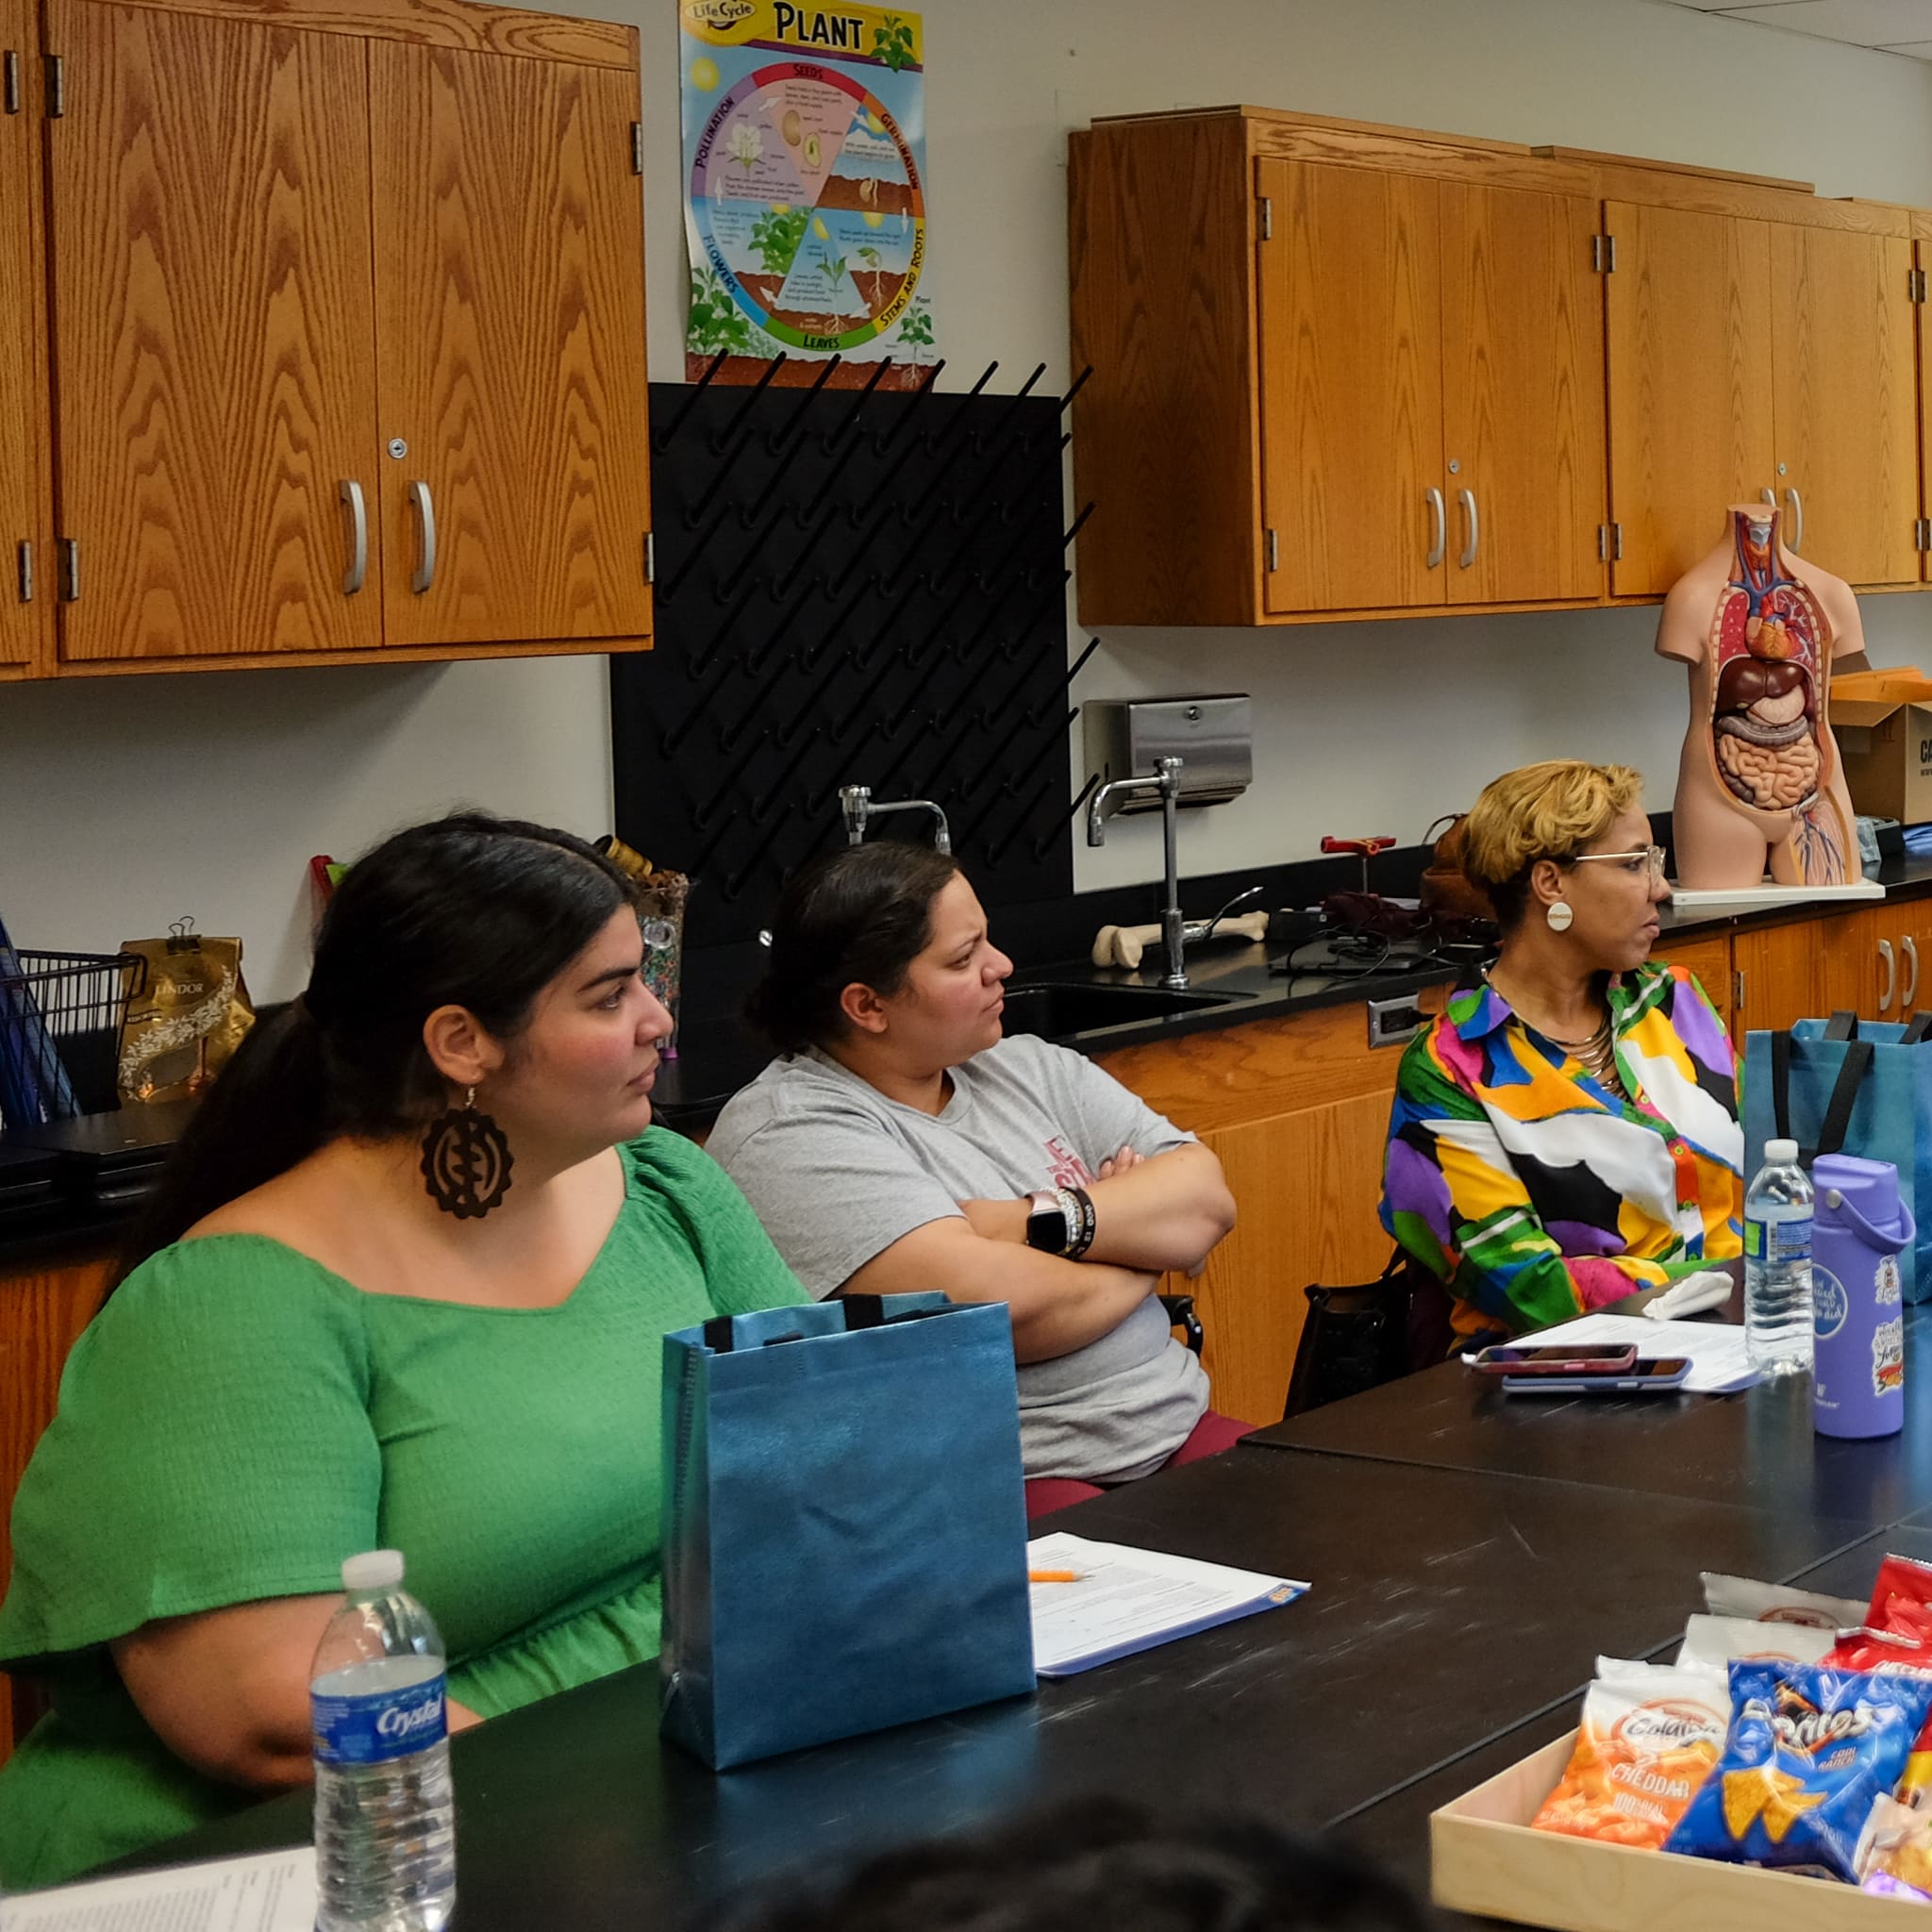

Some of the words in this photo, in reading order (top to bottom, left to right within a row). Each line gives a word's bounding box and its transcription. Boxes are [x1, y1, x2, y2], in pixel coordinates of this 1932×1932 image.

[774, 2, 863, 49] PLANT
[793, 63, 823, 79] SEEDS
[695, 97, 735, 169] POLLINATION
[881, 113, 919, 190] GERMINATION
[704, 234, 739, 293] FLOWERS
[910, 228, 925, 268] ROOTS
[904, 272, 917, 294] AND
[880, 296, 907, 327] STEMS
[804, 334, 841, 349] LEAVES
[155, 983, 205, 995] LINDOR
[376, 1690, 442, 1737] Crystal
[1626, 1717, 1720, 1737] Gold
[1610, 1762, 1690, 1798] CHEDDAR
